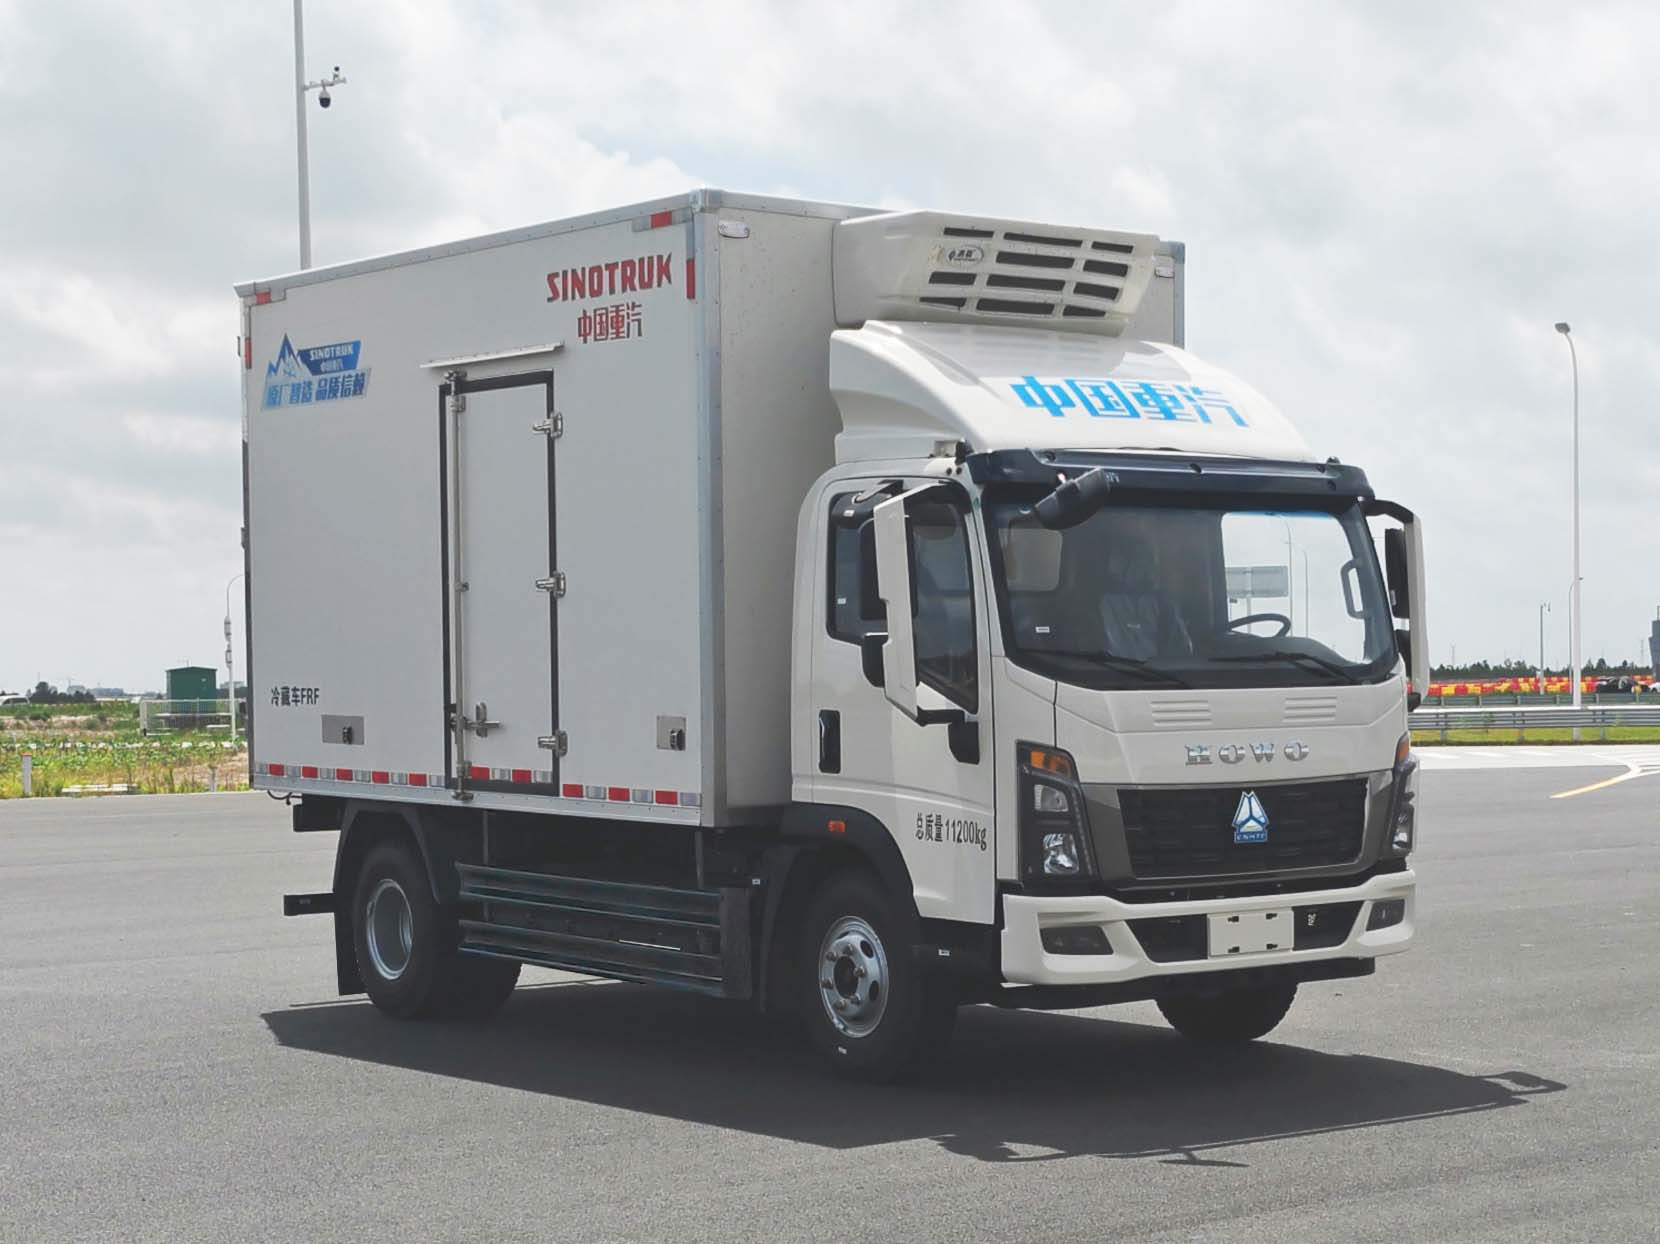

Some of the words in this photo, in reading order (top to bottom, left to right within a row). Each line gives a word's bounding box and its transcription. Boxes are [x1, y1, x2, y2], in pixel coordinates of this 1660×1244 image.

[547, 252, 672, 303] SINOTRUK
[577, 301, 643, 344] 中国重汽
[1009, 375, 1249, 428] 中国重汽
[1184, 741, 1310, 766] HOWO
